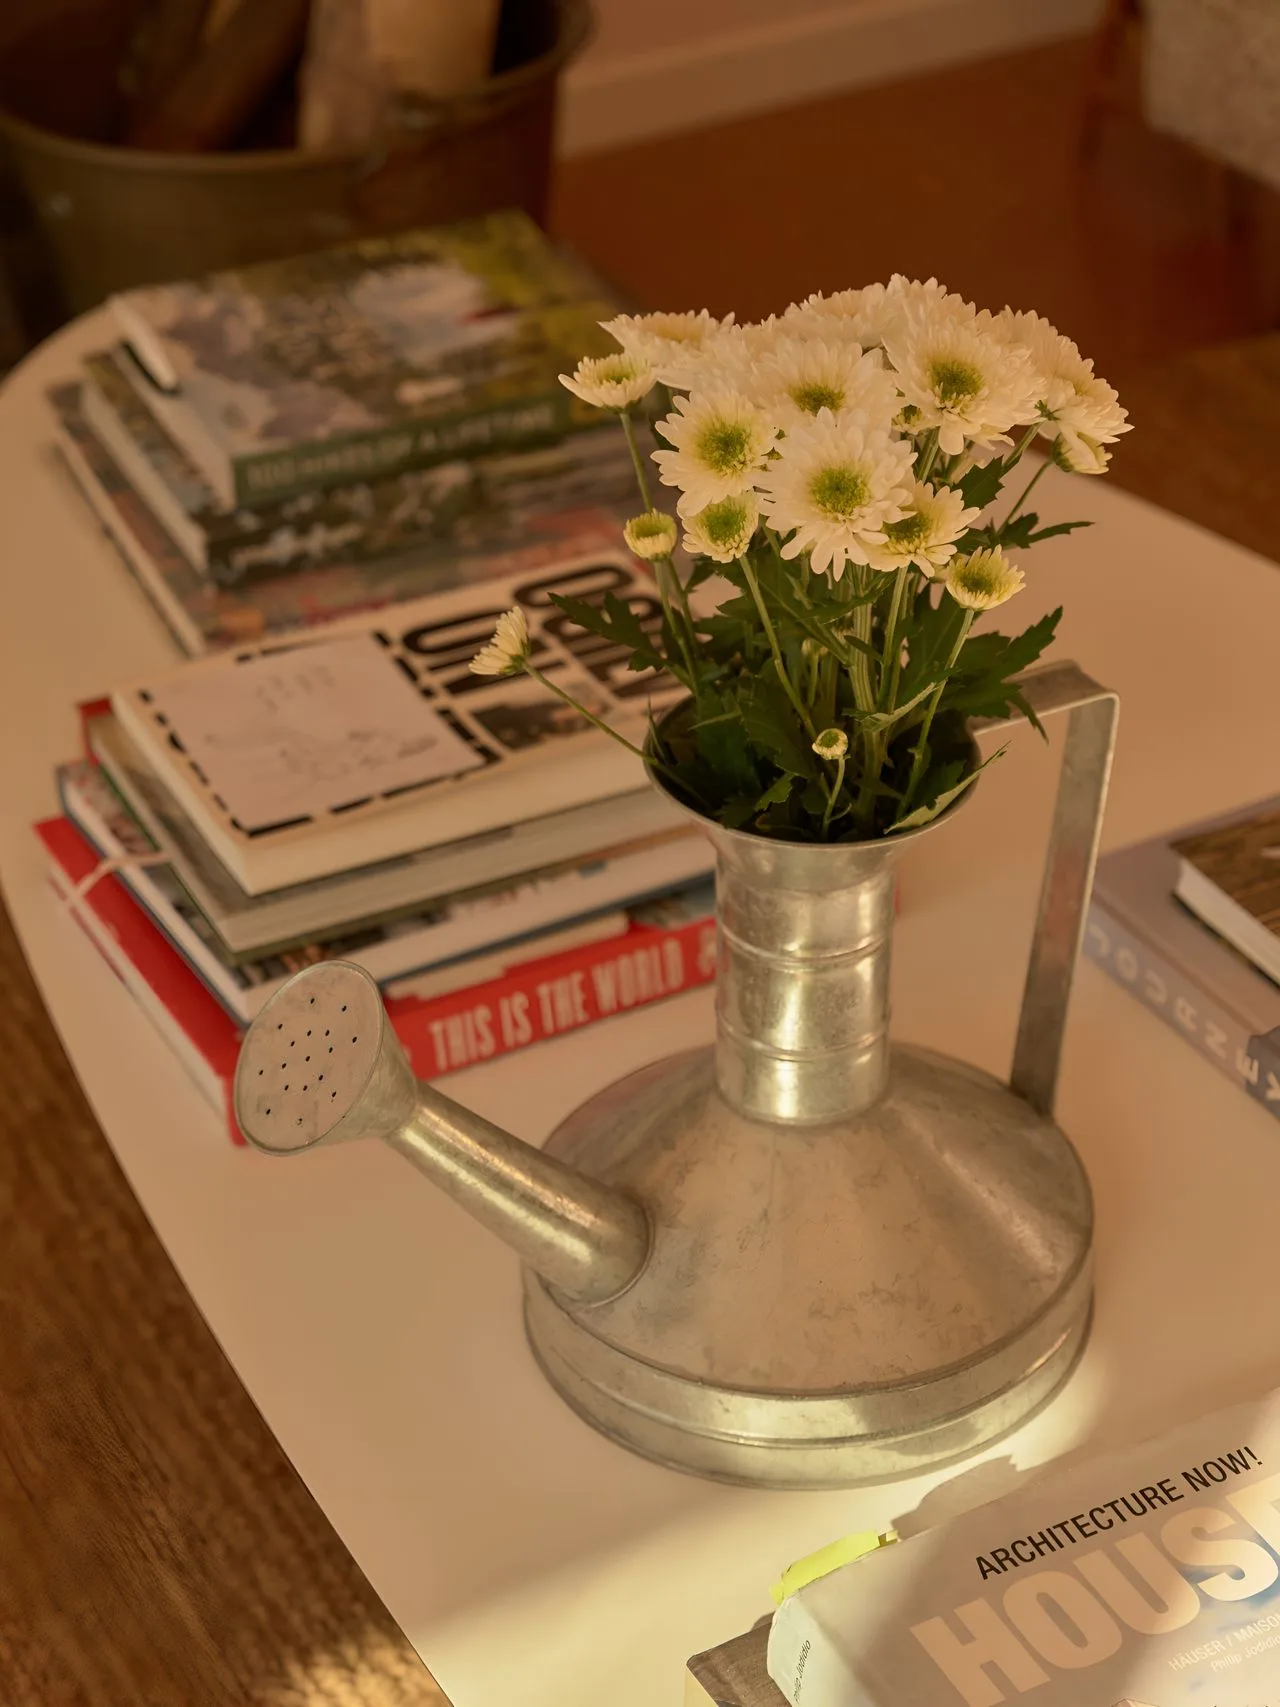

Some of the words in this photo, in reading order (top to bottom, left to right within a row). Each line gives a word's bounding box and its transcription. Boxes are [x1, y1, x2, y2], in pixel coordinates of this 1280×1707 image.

[428, 1004, 496, 1072] THIS
[500, 991, 533, 1048] IS
[536, 971, 589, 1034] THE
[592, 937, 685, 1012] WORLD
[975, 1478, 1184, 1580] ARCHITECTURE
[1181, 1446, 1263, 1491] NOW!
[1167, 1639, 1226, 1672] HÄUSER
[1233, 1612, 1280, 1643] MAISO
